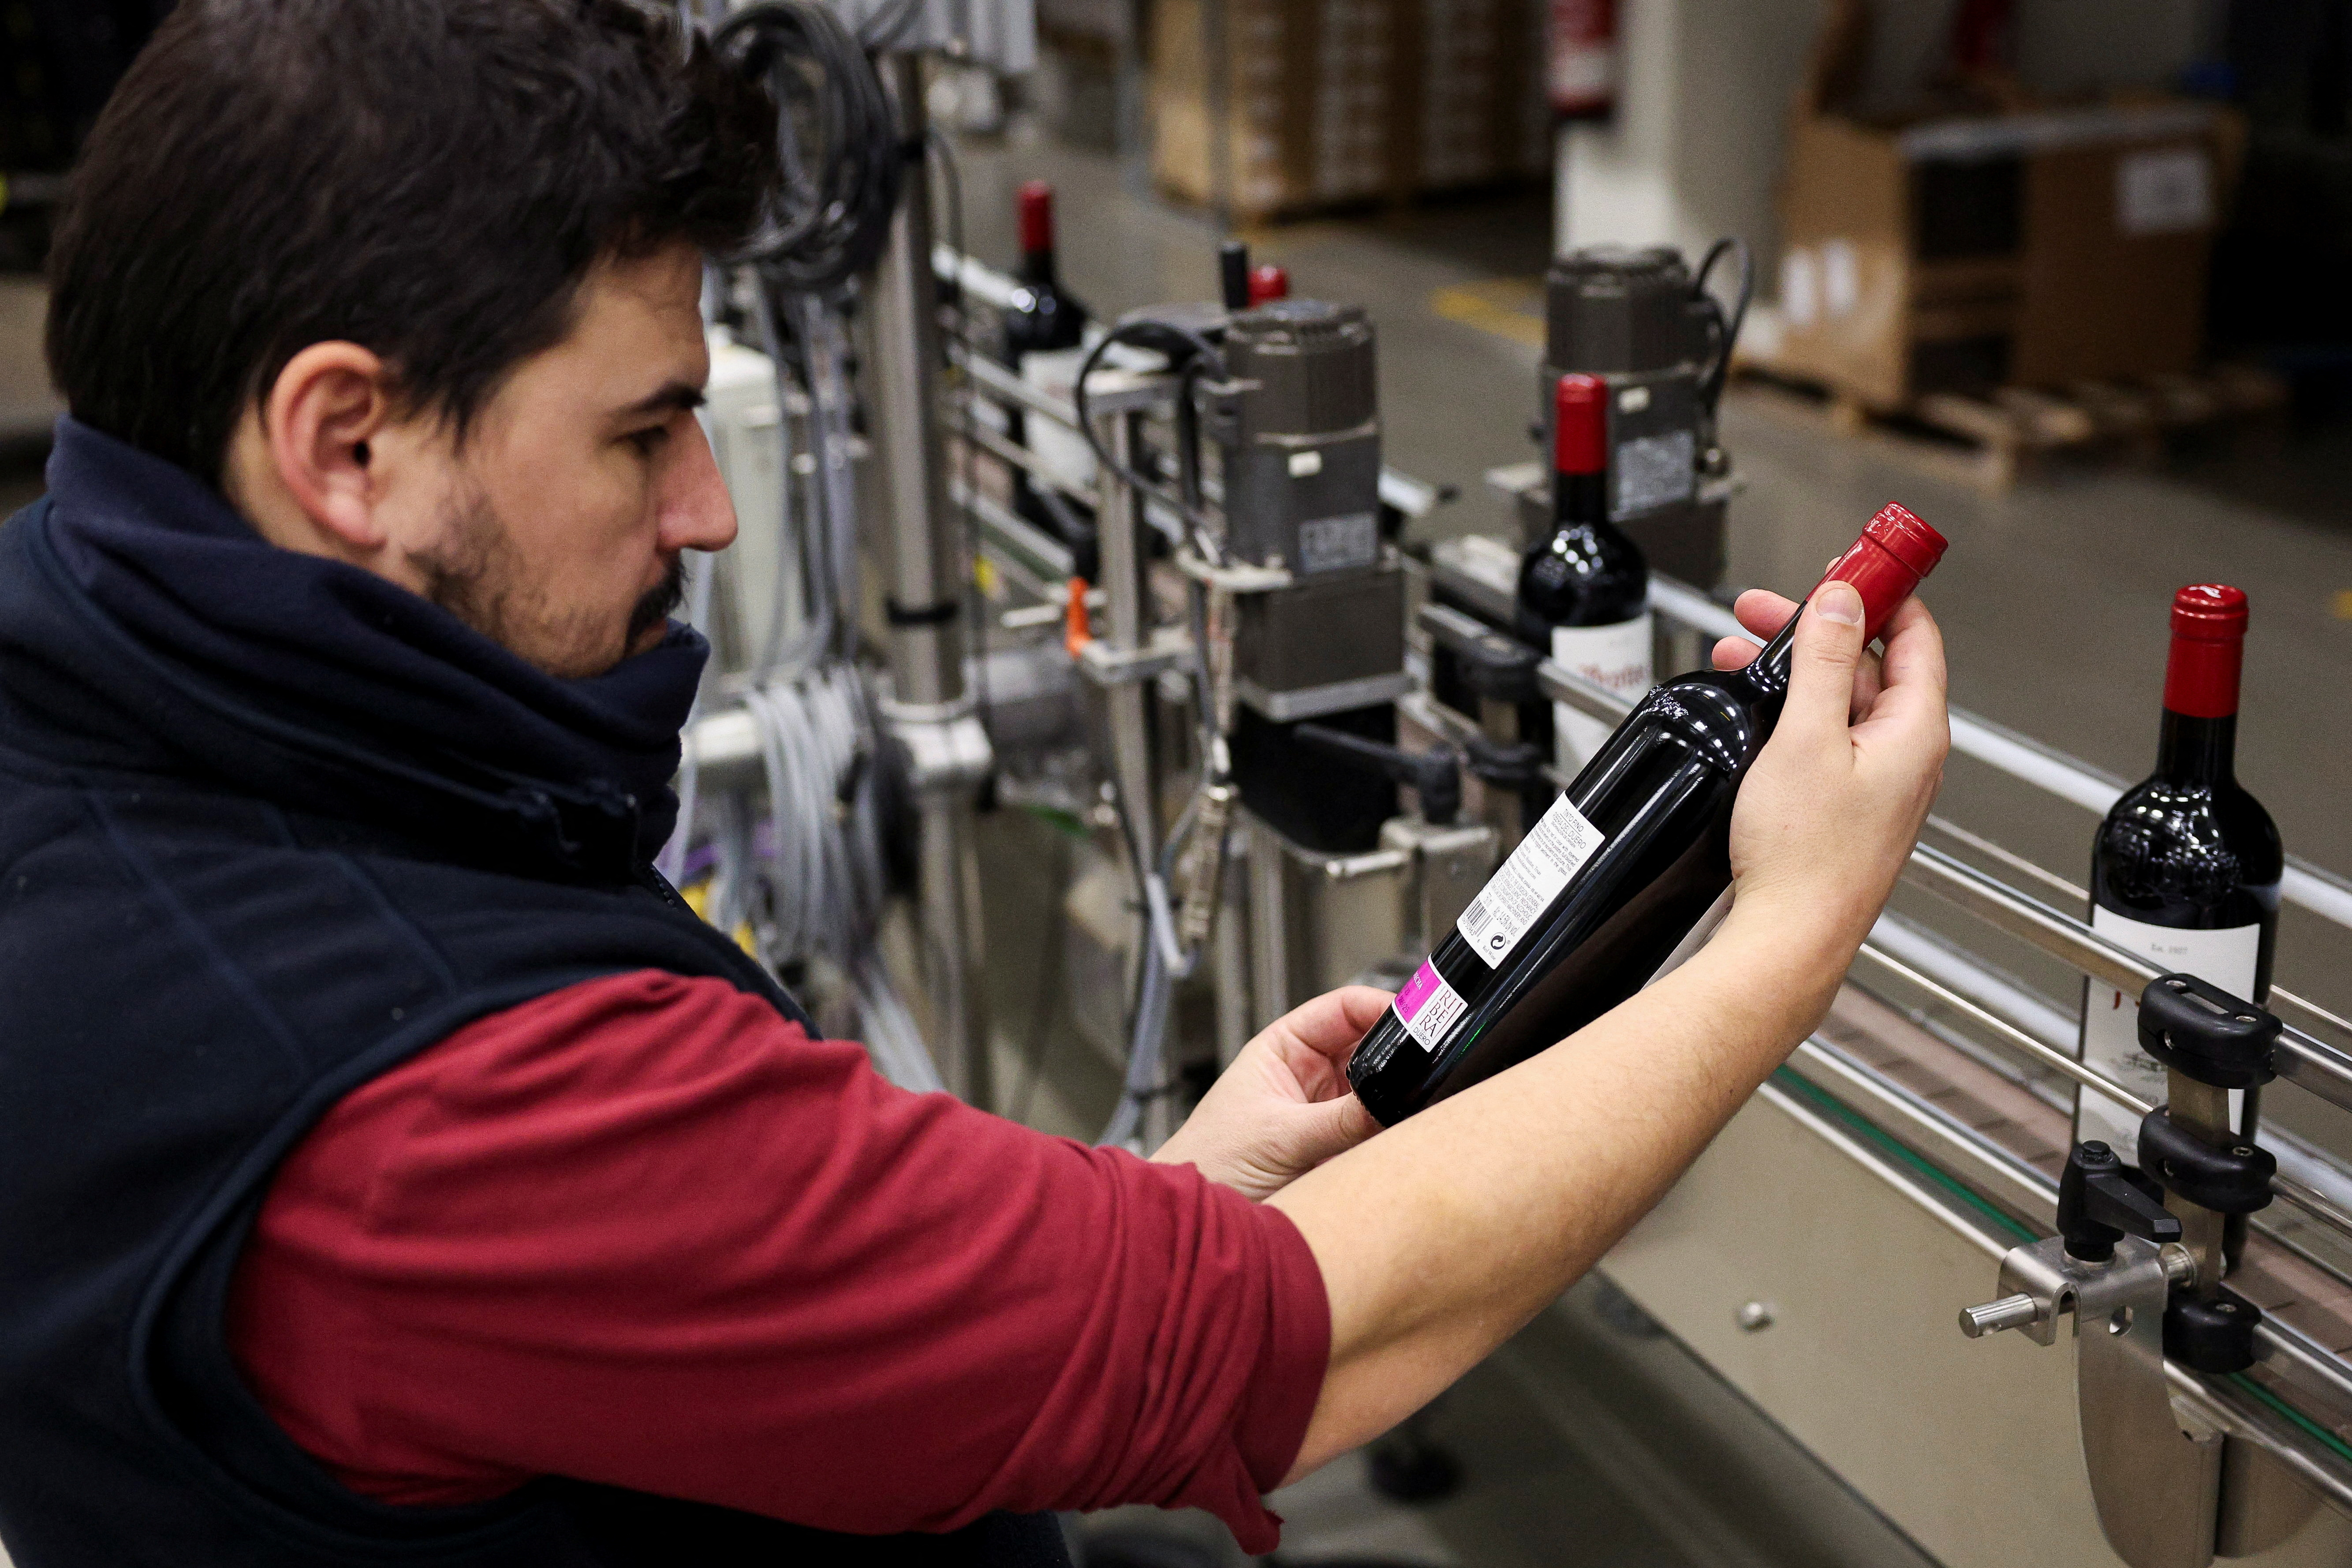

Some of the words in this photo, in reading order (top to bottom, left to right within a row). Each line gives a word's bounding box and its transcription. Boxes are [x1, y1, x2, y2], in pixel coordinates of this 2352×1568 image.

[1562, 808, 1574, 822] TINTO
[1571, 819, 1584, 832] FINO
[1561, 823, 1570, 834] DEL
[1568, 830, 1587, 849] DUERO
[1564, 856, 1575, 867] bodied
[1568, 851, 1579, 862] layered
[1557, 866, 1567, 876] glass.
[1564, 863, 1572, 872] This
[1519, 896, 1537, 915] PREGNANCY
[1526, 894, 1540, 910] GENERAL,
[1516, 903, 1533, 920] ALCOHOLIC
[1508, 925, 1520, 937] vol.
[1413, 1027, 1431, 1046] DUERO
